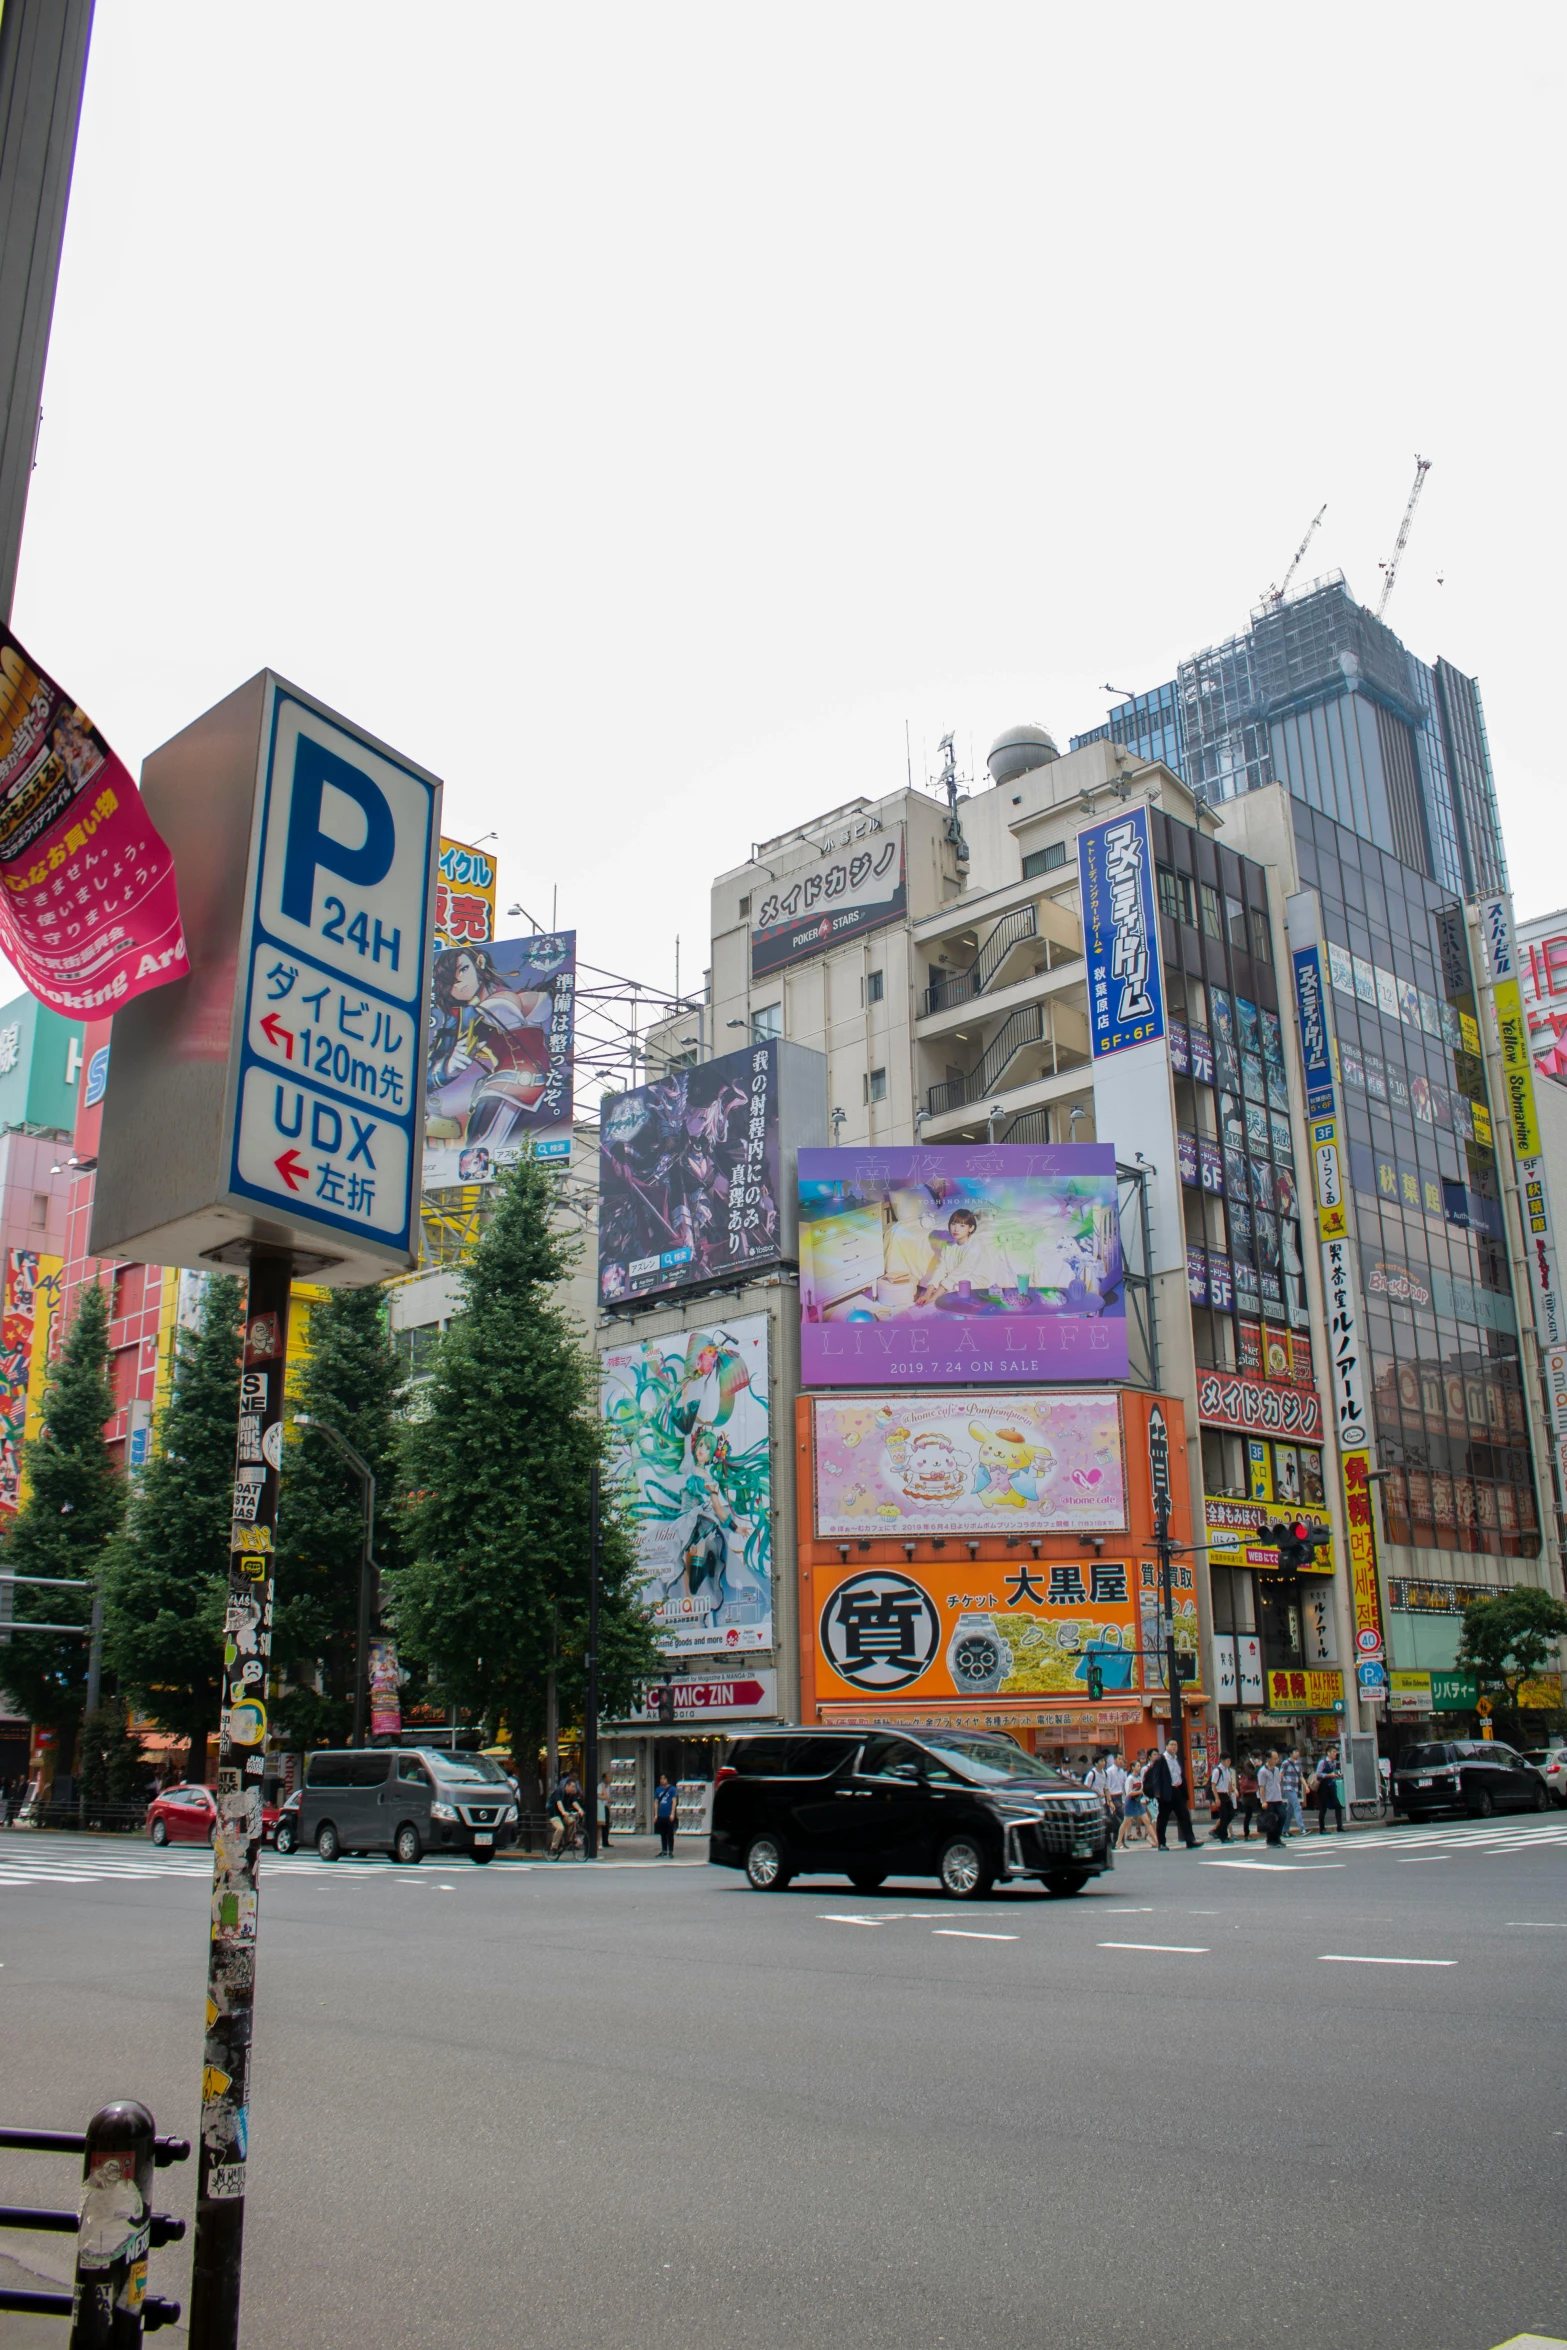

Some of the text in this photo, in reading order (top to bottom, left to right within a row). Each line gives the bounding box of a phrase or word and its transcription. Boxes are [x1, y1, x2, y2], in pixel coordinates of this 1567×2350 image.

[280, 731, 396, 929] P
[439, 847, 492, 888] イクル
[759, 842, 896, 929] メイドカジノ
[1088, 846, 1103, 949] トレーディングカードゲーム
[322, 895, 402, 973] 24H
[793, 909, 859, 948] POKER STARS
[1488, 902, 1511, 975] スーパービル
[266, 961, 403, 1054] ダイビル
[1094, 967, 1109, 1032] 秋葉原店
[1382, 986, 1393, 1003] 12
[544, 973, 574, 1117] 準備は整ったぞ。
[1501, 1017, 1519, 1065] Yellow
[301, 1028, 406, 1107] 120m先
[1192, 1053, 1213, 1081] 7F
[1395, 1081, 1404, 1097] 10
[1473, 1111, 1490, 1127] GAME
[1509, 1075, 1529, 1151] Submarine
[274, 1084, 377, 1171] UDX
[744, 1050, 770, 1229] 我の射程内にのみ
[1317, 1126, 1332, 1141] 3F
[1202, 1163, 1222, 1190] 6F
[1321, 1148, 1336, 1206] りらくる
[1523, 1159, 1537, 1171] 5F
[315, 1166, 376, 1219] 左折
[964, 1197, 996, 1205] NANJO
[1379, 1163, 1440, 1215] 秋葉館
[728, 1164, 746, 1255] 真理あり
[1527, 1183, 1546, 1233] 秋葉館
[631, 1261, 656, 1274] アズレン
[1211, 1279, 1232, 1307] 5F
[1263, 1300, 1283, 1318] Stand
[820, 1324, 1110, 1355] LIVE A LIFE
[1329, 1242, 1363, 1423] 喫茶室ルノアール
[607, 1355, 632, 1369] 初音ミク
[890, 1359, 1039, 1374] 2019.7.24 ON SALE
[902, 1402, 1033, 1427] @home Pompompurin
[1201, 1376, 1319, 1435] メイドカジノ
[240, 1415, 260, 1431] KON
[1251, 1446, 1262, 1459] 3F
[235, 1482, 261, 1495] OAT
[1060, 1495, 1094, 1506] @home
[1344, 1456, 1373, 1528] 免税
[1207, 1504, 1266, 1526] 全身もみほぐし
[649, 1527, 676, 1542] Miku
[947, 1561, 1130, 1609] チケット 大黒屋
[656, 1596, 711, 1617] amiami
[674, 1638, 692, 1648] goods
[693, 1637, 705, 1646] and
[706, 1636, 723, 1645] more
[835, 1586, 924, 1677] 質
[1314, 1601, 1329, 1659] ルノアール
[1361, 1634, 1376, 1647] 40
[672, 1674, 690, 1684] Support
[690, 1675, 698, 1683] for
[698, 1673, 721, 1682] Magazine
[1221, 1673, 1261, 1687] ルノアール
[1273, 1671, 1307, 1699] 免税
[1308, 1671, 1323, 1691] TAX
[1323, 1672, 1339, 1691] FREE
[1364, 1667, 1375, 1684] P
[648, 1684, 734, 1707] CMIC ZIN
[1433, 1682, 1476, 1700] リバティー
[1097, 1710, 1142, 1723] 無料査定
[284, 1755, 295, 1796] KIRIN
